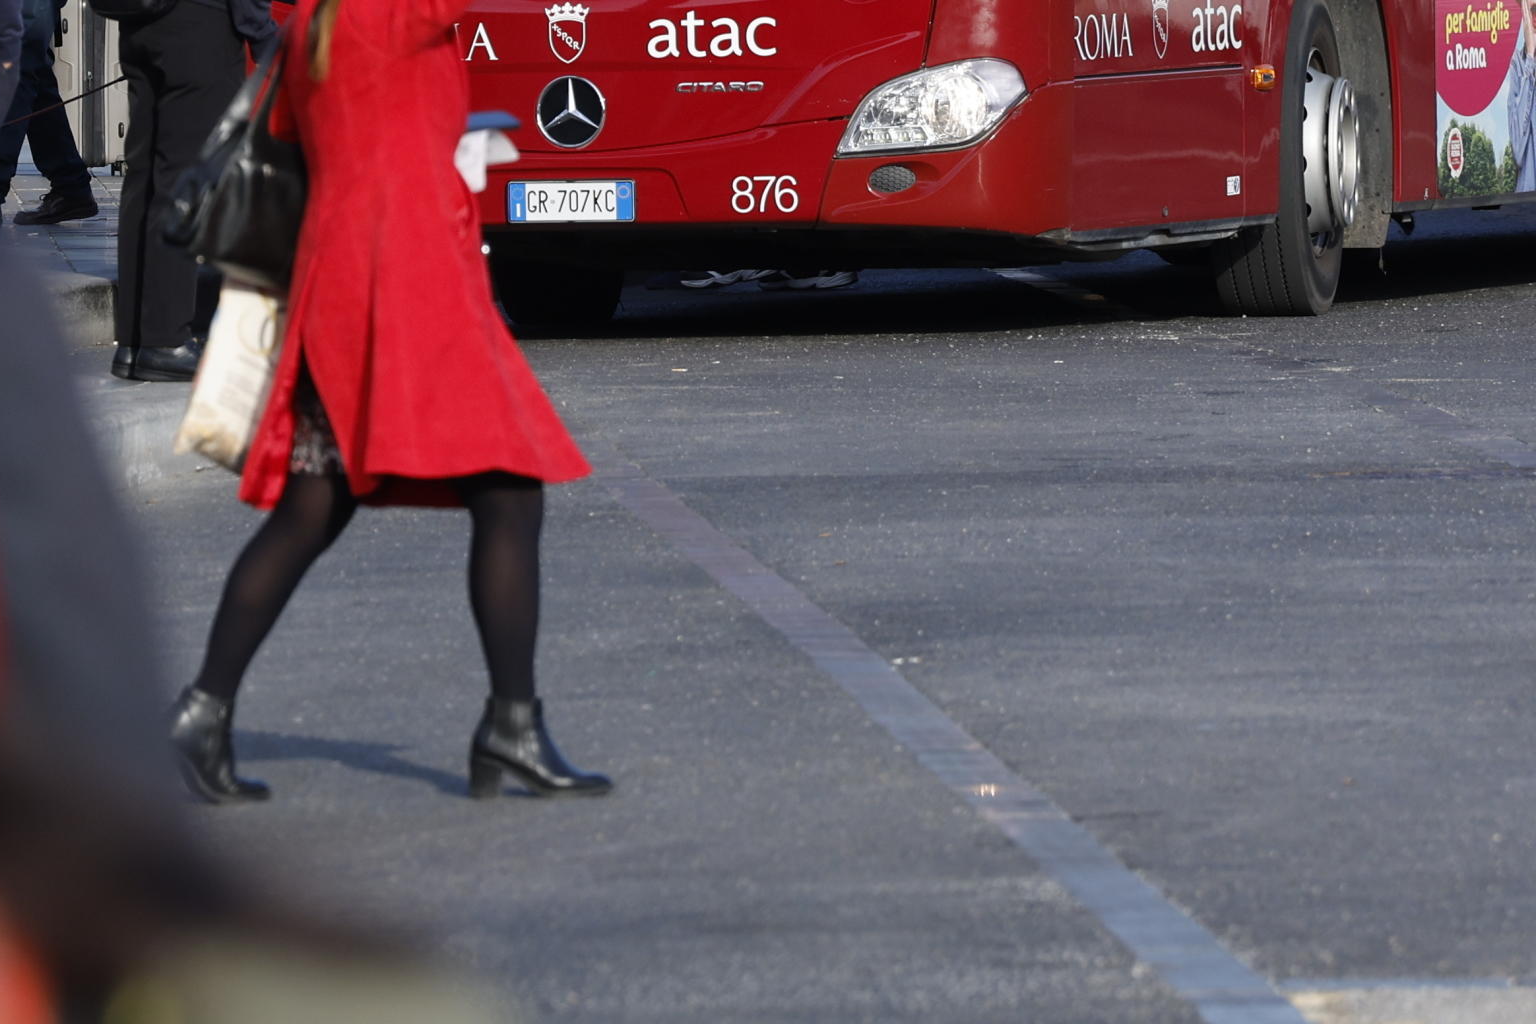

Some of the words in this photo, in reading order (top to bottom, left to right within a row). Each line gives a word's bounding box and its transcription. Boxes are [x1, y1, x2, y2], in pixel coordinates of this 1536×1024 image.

[647, 10, 777, 59] atac
[1074, 12, 1134, 60] ROMA
[1446, 9, 1465, 45] per
[1466, 0, 1510, 45] famiglie
[1446, 48, 1454, 71] a
[1455, 43, 1487, 70] Roma
[676, 81, 764, 93] CITARO
[730, 174, 799, 214] 876
